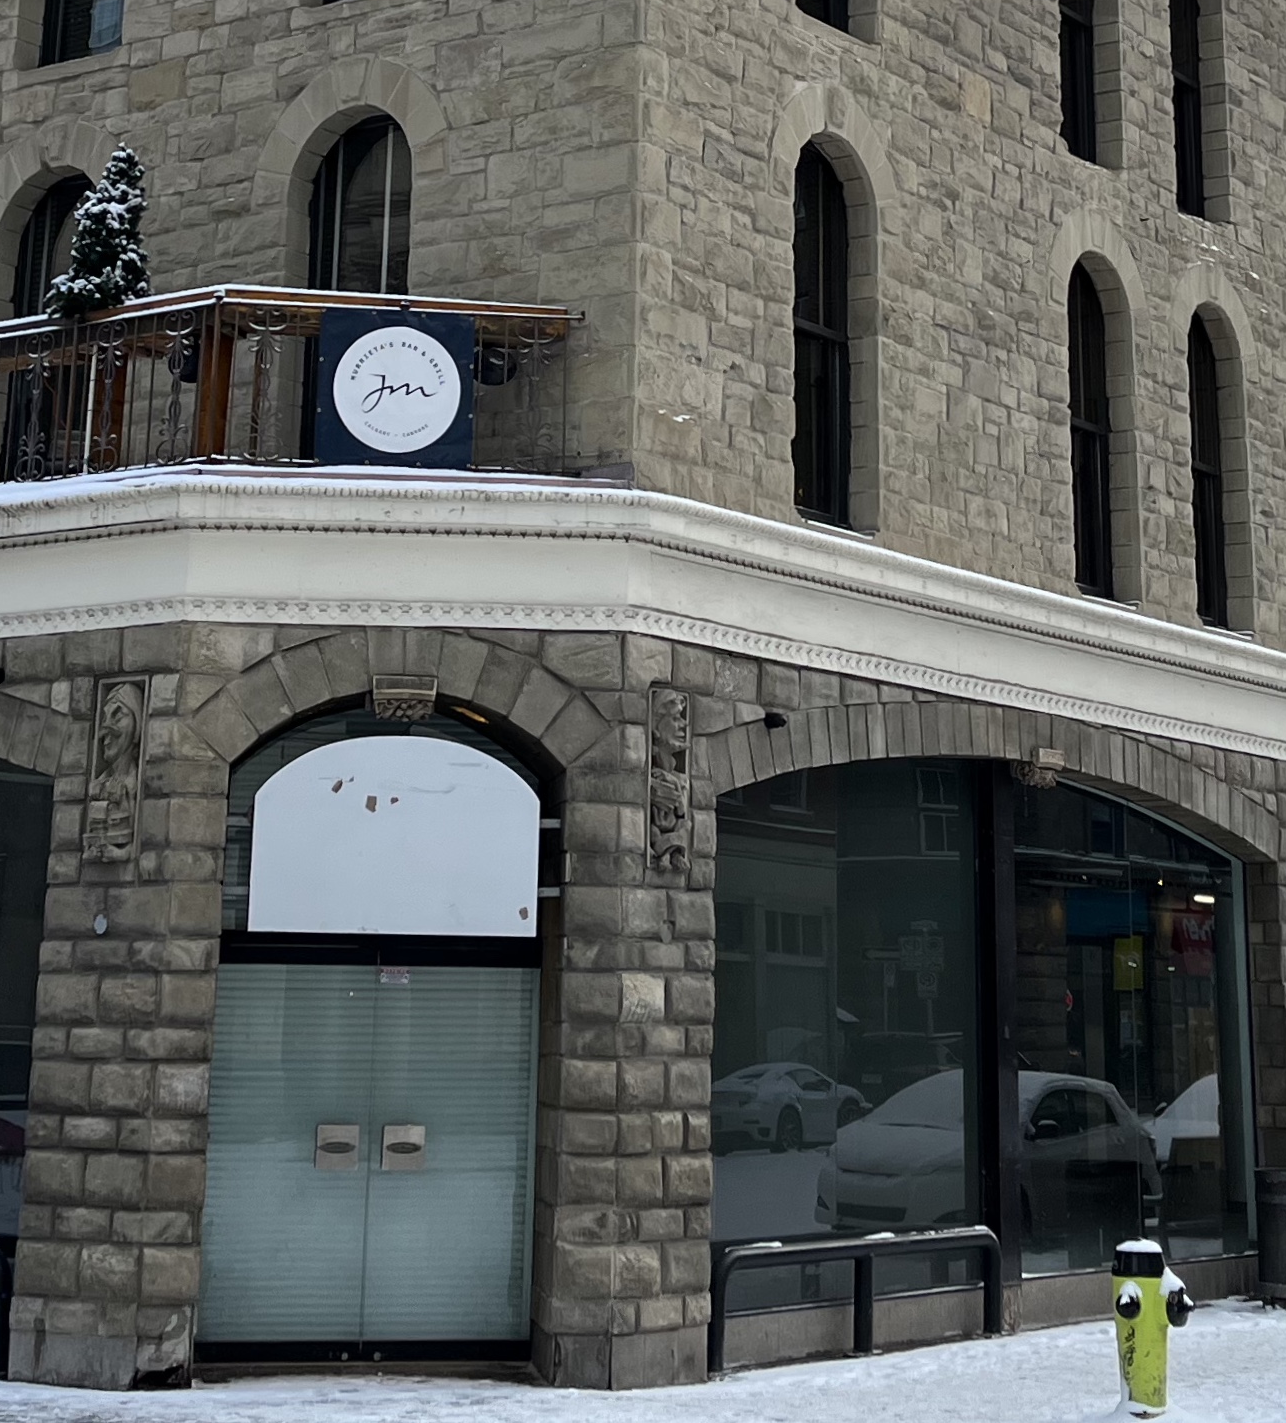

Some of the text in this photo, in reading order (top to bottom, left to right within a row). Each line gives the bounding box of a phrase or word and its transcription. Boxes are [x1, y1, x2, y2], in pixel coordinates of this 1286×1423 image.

[350, 341, 395, 381] MURRIETA'S
[401, 341, 419, 352] BAR
[429, 357, 446, 386] GRILL
